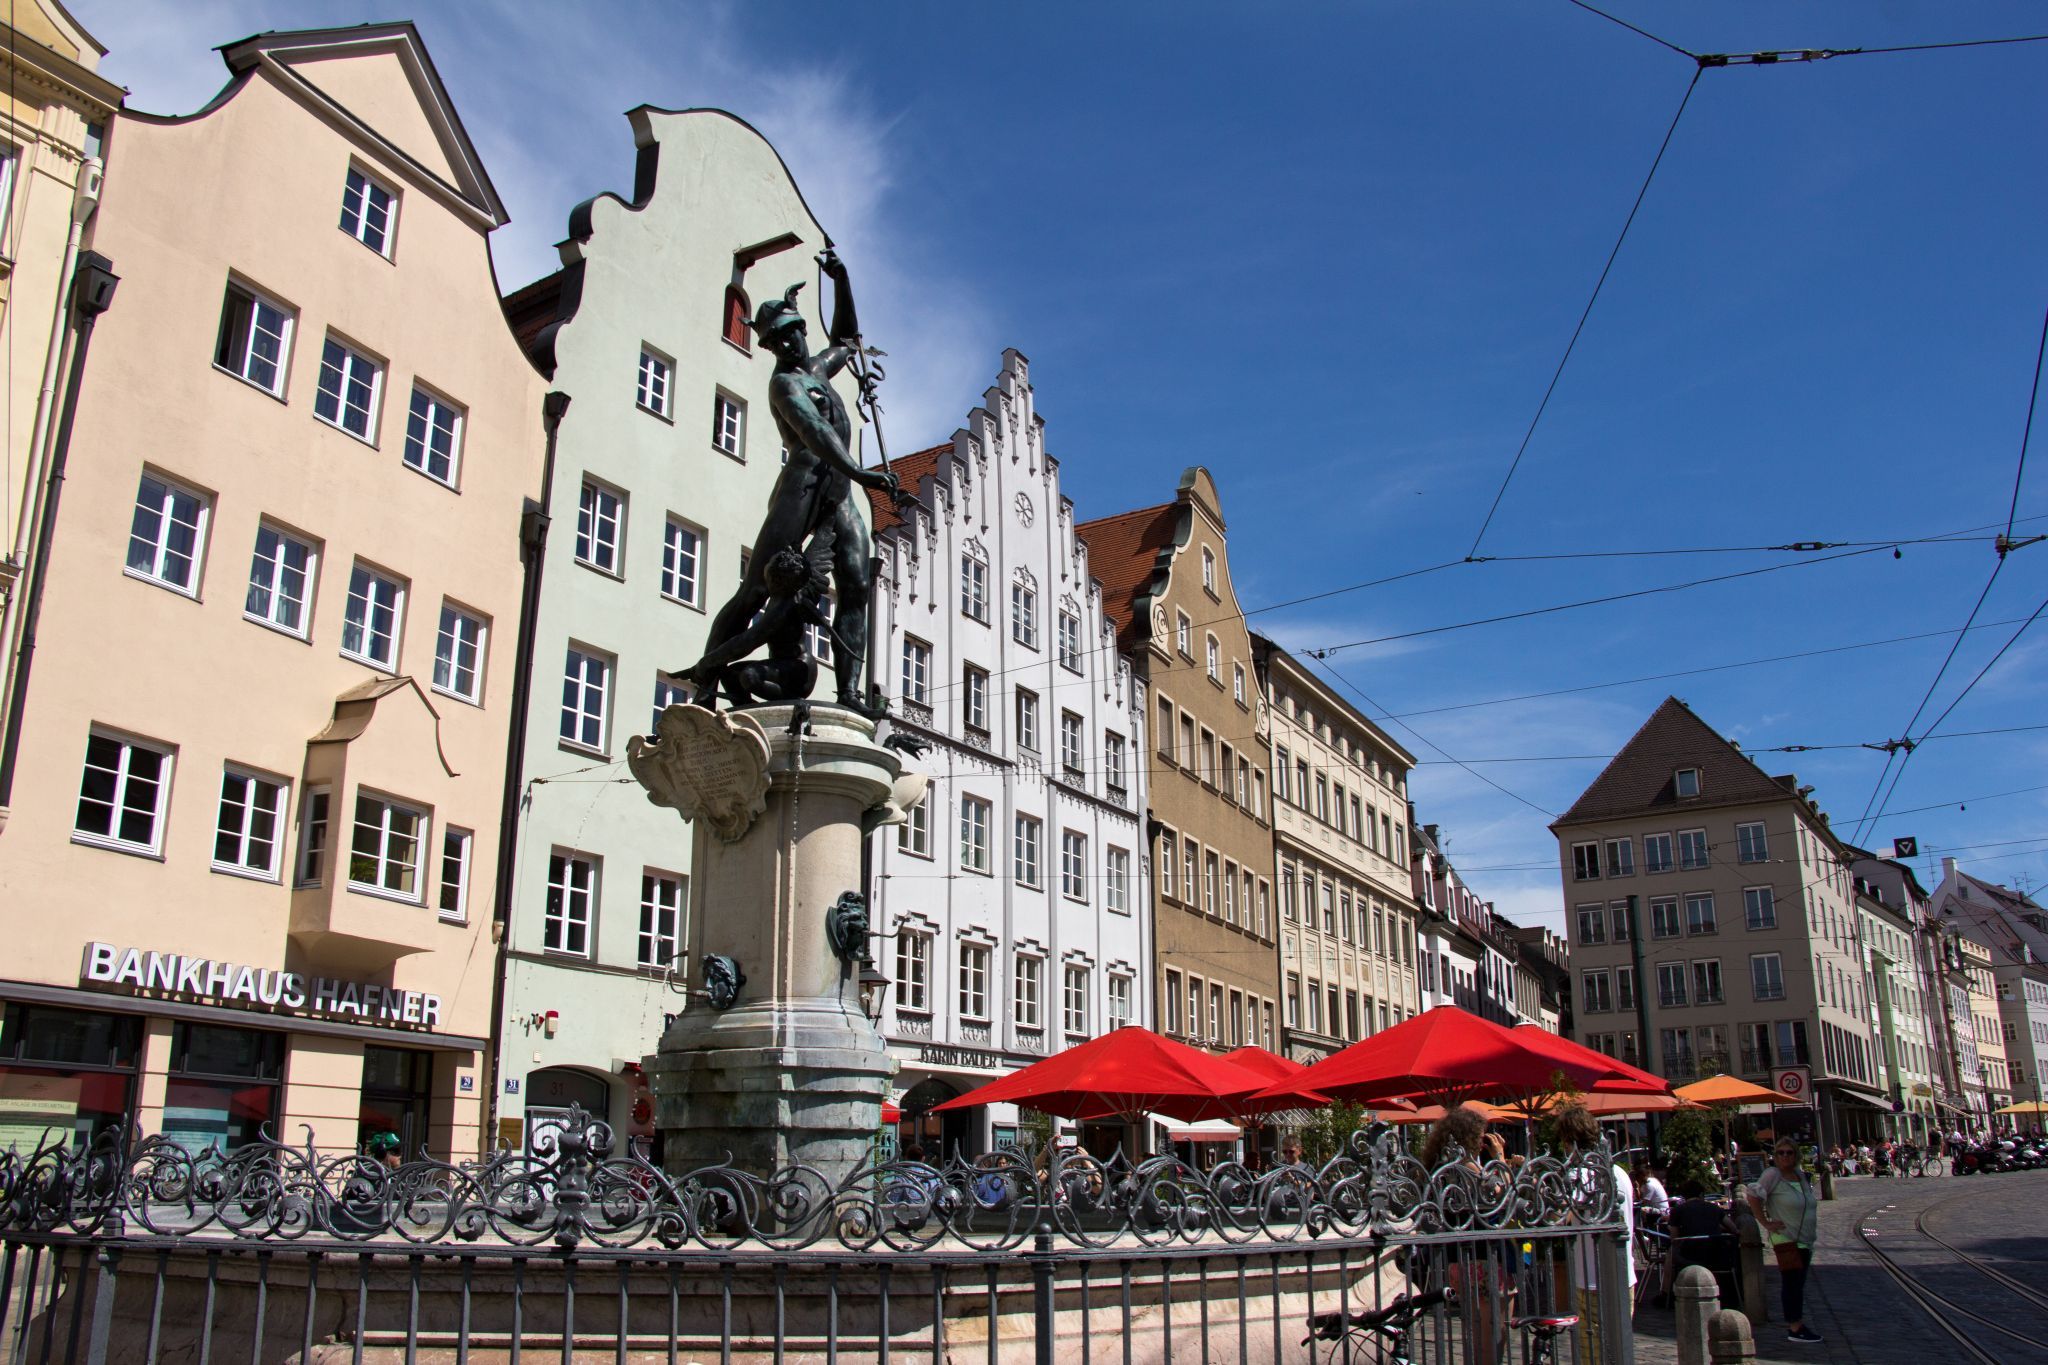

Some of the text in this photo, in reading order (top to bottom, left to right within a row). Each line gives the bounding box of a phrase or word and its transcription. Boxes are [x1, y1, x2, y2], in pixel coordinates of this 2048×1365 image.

[86, 941, 442, 1026] BANKHAUS HAFNER
[920, 1045, 997, 1068] KARIN BAUER
[508, 1080, 517, 1088] 31
[551, 1082, 564, 1096] 31
[1785, 1078, 1798, 1089] 20
